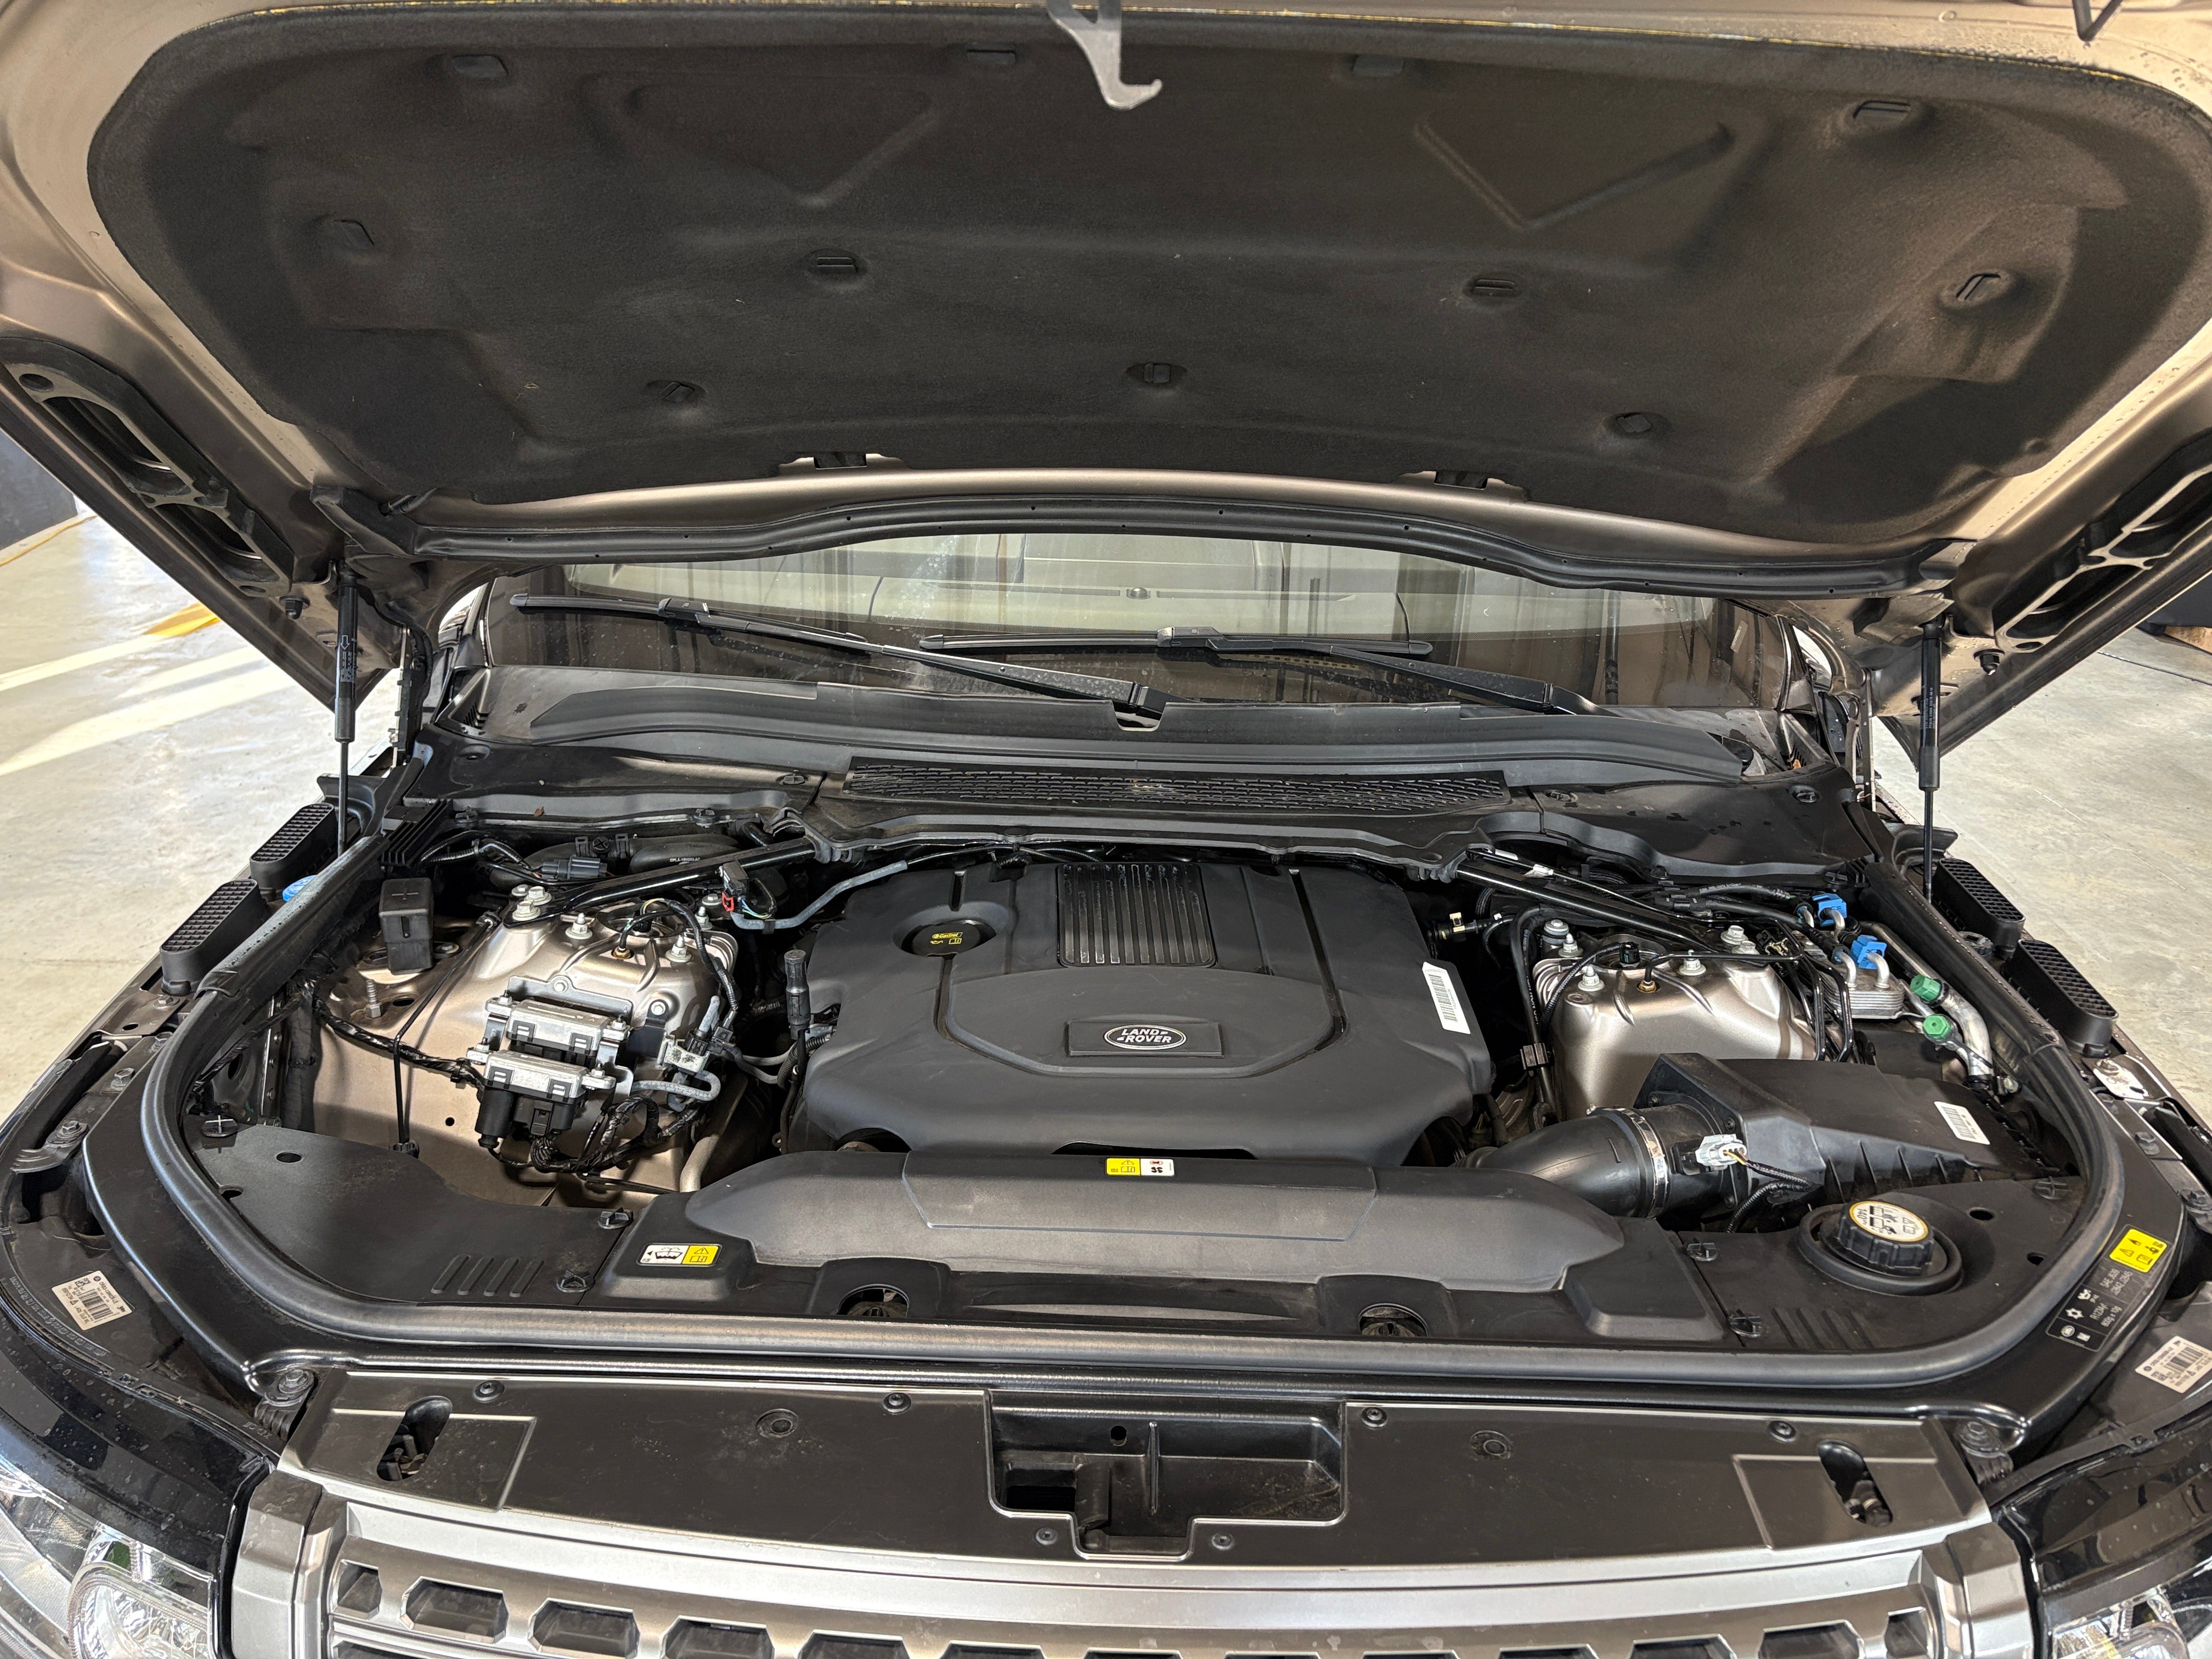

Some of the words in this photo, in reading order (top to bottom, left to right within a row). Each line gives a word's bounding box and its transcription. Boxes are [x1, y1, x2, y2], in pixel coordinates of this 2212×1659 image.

[1857, 1209, 1867, 1219] 140
[2100, 1278, 2114, 1288] SAE
[2089, 1303, 2108, 1321] R1234yf
